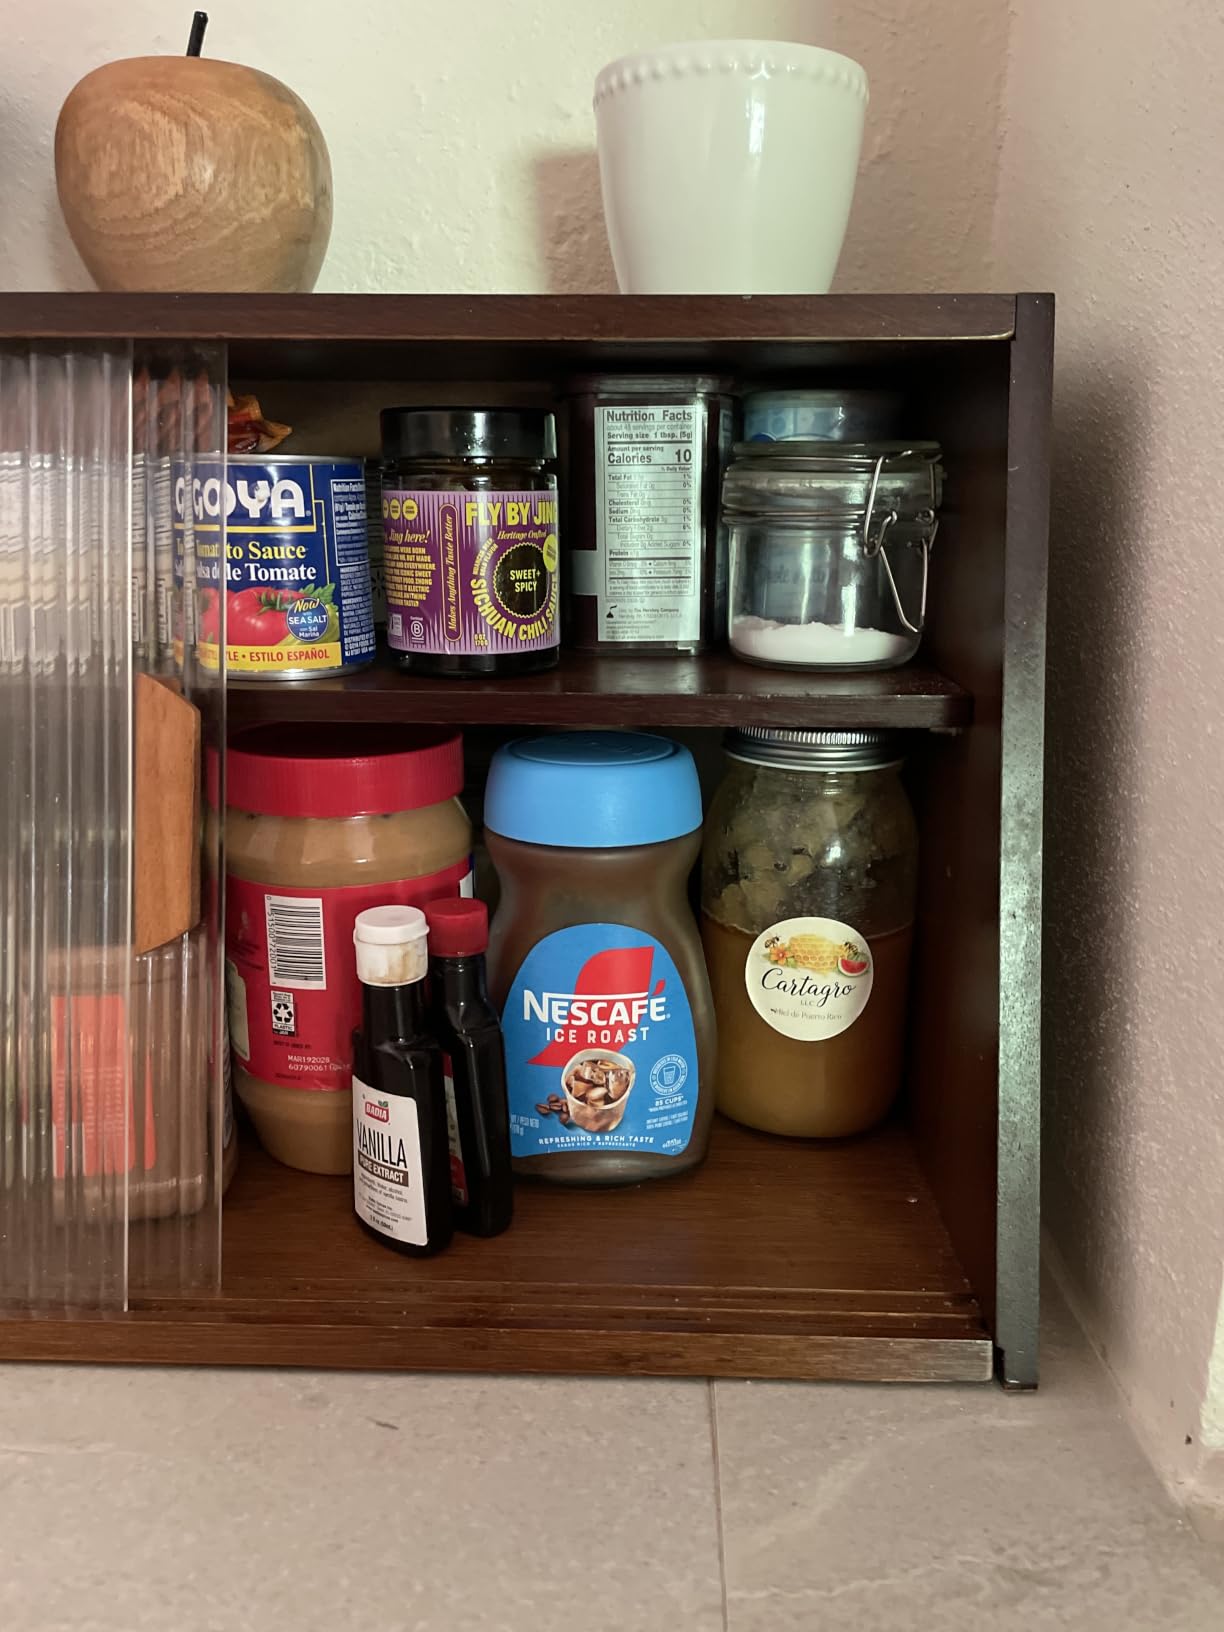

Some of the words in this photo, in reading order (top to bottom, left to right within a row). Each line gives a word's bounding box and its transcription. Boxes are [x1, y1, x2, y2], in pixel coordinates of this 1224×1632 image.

[606, 410, 655, 421] Nutrition
[662, 410, 693, 421] Facts
[607, 432, 633, 440] Serving
[608, 452, 652, 464] Calories
[675, 449, 692, 463] 10
[642, 445, 664, 453] serving
[176, 477, 306, 521] GOYA
[465, 502, 501, 526] FLY
[507, 502, 531, 526] BY
[404, 528, 431, 544] here!
[444, 513, 455, 543] Better
[497, 530, 529, 540] Heritage
[248, 541, 307, 560] Sauce
[444, 542, 456, 567] Taste
[244, 564, 317, 581] Tomate
[446, 566, 457, 606] Anything
[514, 580, 538, 593] SPICY
[294, 598, 320, 614] Now
[470, 578, 518, 639] SICHUAN
[518, 617, 549, 641] CHILI
[288, 616, 307, 625] SEA
[307, 614, 328, 624] SALT
[447, 605, 458, 632] Makes
[249, 651, 284, 662] ESTILO
[287, 648, 330, 661] ESPAÑOL
[761, 967, 857, 1008] Cartagro
[523, 980, 667, 1026] NESCAFÉ
[791, 1009, 800, 1018] de
[801, 1010, 826, 1020] Puerto
[826, 1011, 842, 1020] Rico
[546, 1027, 578, 1044] ICE
[586, 1026, 650, 1044] ROAST
[365, 1102, 388, 1121] BADIA
[356, 1119, 408, 1169] VANILLA
[538, 1136, 592, 1145] REFRESHING
[628, 1136, 654, 1144] TASTE
[373, 1162, 405, 1184] EXTRACT
